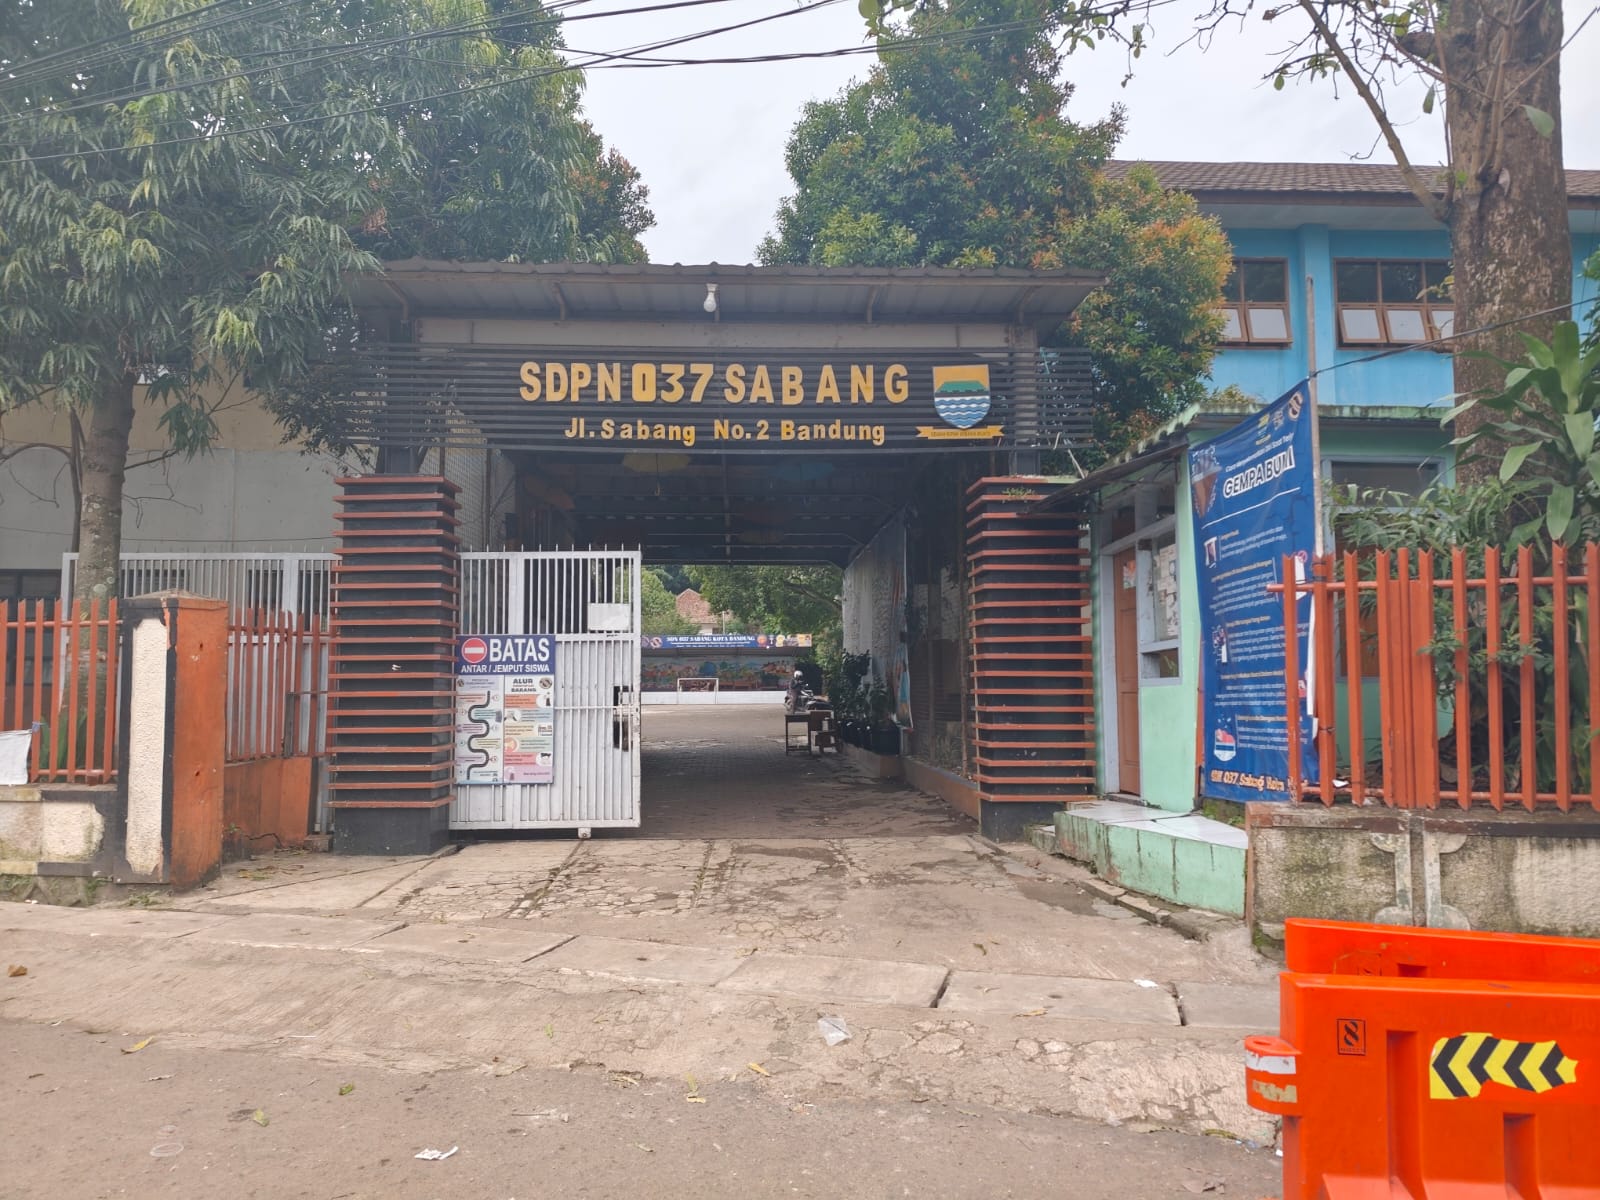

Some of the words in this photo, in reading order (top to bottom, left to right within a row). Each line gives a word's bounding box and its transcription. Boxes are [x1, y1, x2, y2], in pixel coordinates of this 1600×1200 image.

[519, 361, 621, 402] SDPN
[631, 363, 714, 403] 037
[724, 363, 909, 405] SABANG
[781, 419, 885, 446] Bandung
[489, 638, 550, 662] BATAS
[461, 664, 487, 673] ANTAR
[492, 664, 523, 673] JEMPUT
[524, 664, 550, 673] SISWA
